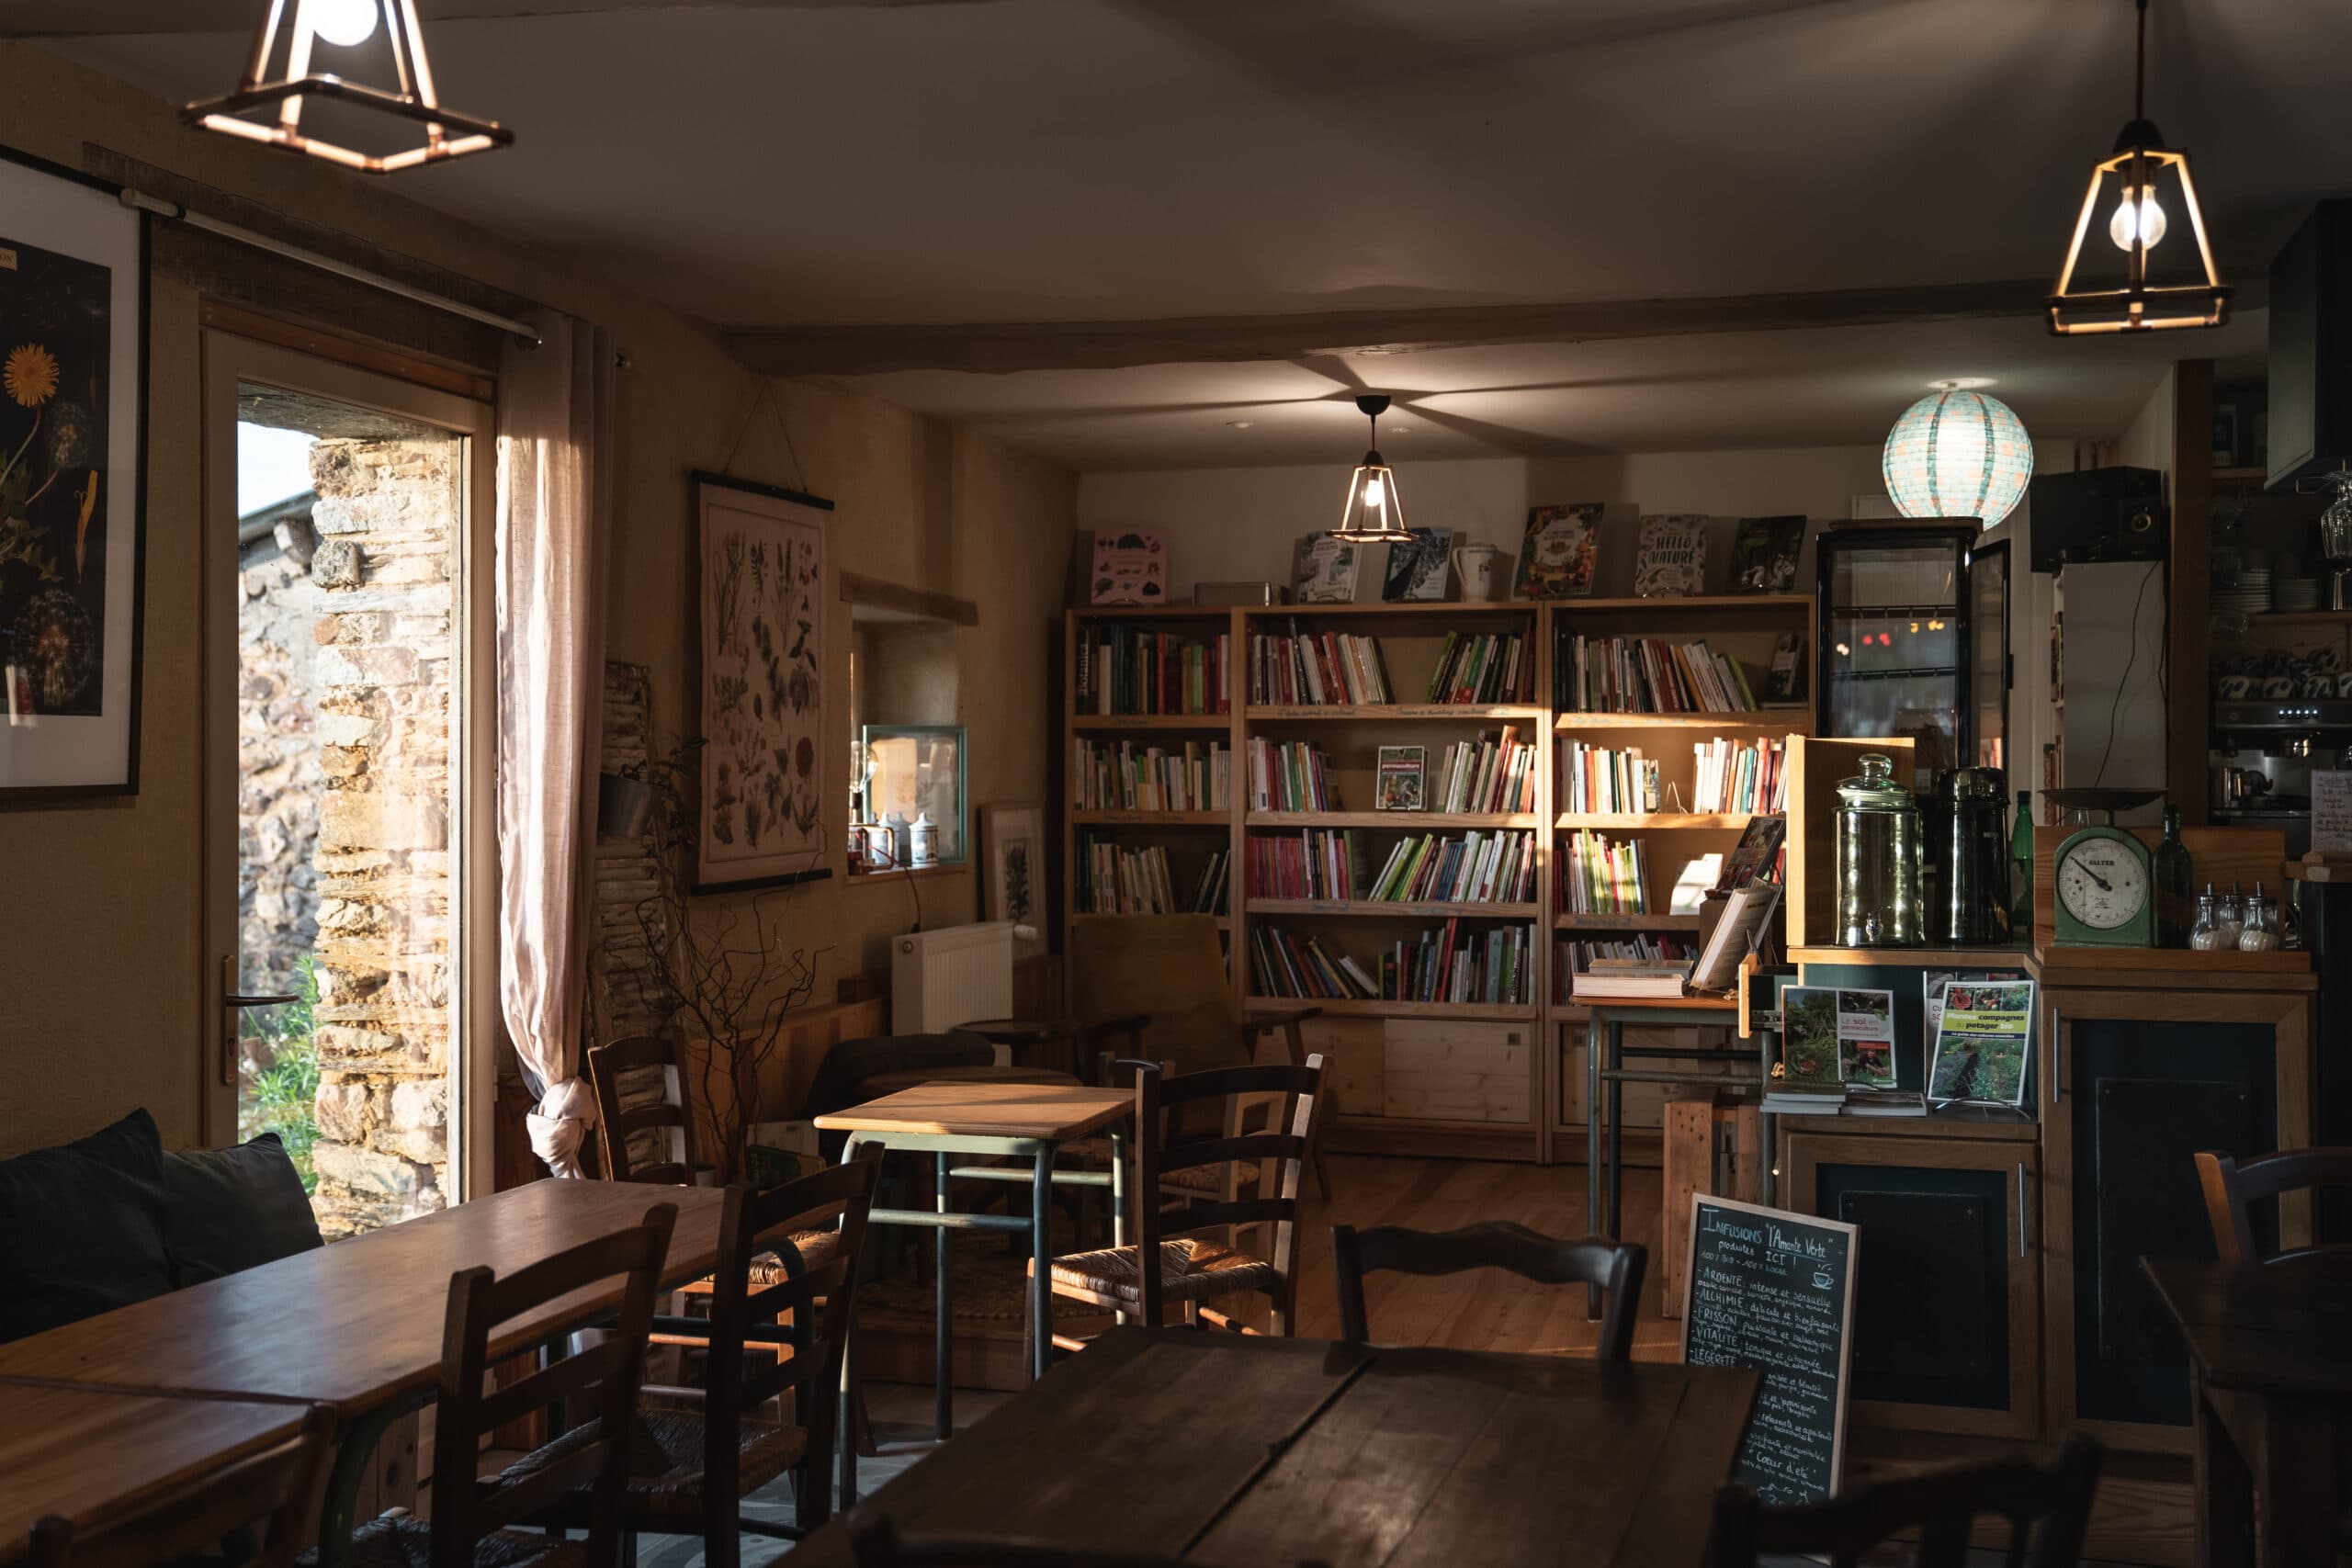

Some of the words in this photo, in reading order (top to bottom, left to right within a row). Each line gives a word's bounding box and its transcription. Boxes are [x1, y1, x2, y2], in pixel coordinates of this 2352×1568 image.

[1657, 536, 1691, 550] HELLO
[1648, 550, 1694, 564] NATURE
[1965, 1021, 1999, 1030] potager
[1978, 1014, 2025, 1022] compagnes
[1702, 1207, 1763, 1244] INFUSIONS
[1765, 1251, 1787, 1266] ICI
[1703, 1266, 1743, 1287] ARDENTE
[1700, 1288, 1745, 1309] ALCHIMIE
[1698, 1305, 1737, 1326] FRISSON
